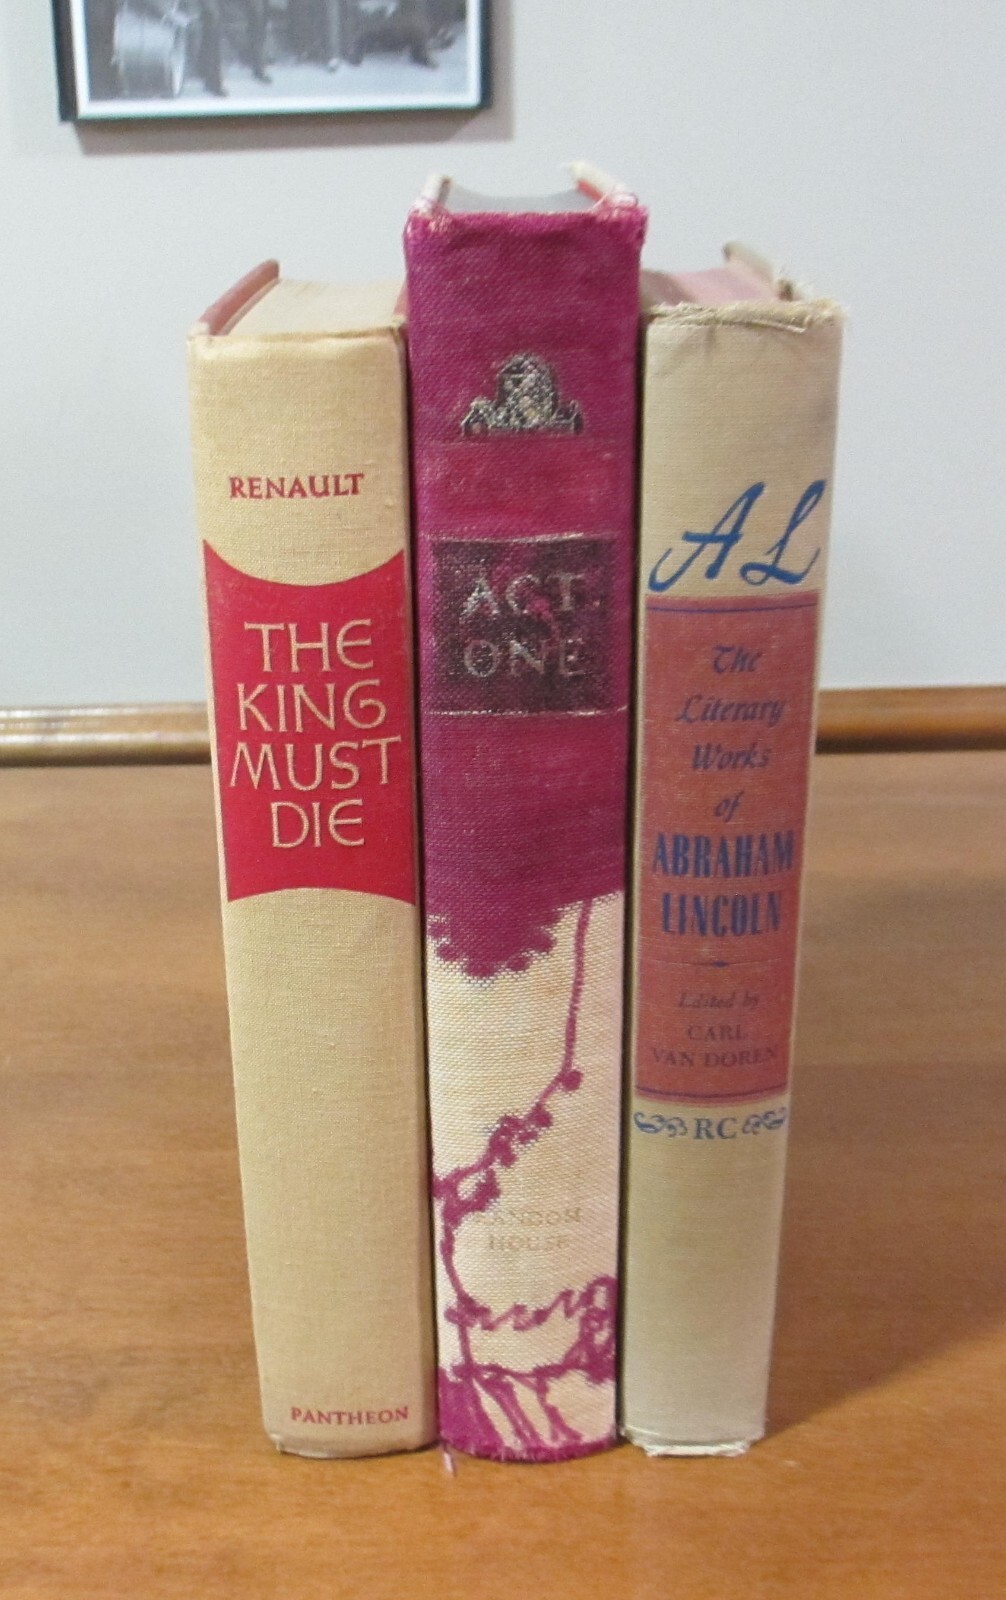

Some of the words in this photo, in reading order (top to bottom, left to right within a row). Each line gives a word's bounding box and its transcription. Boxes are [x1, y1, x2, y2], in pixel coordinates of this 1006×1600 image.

[228, 472, 365, 500] RENAULT
[459, 573, 587, 621] ACT
[244, 618, 374, 673] THE
[463, 636, 587, 678] ONE
[711, 645, 762, 675] The
[236, 678, 387, 733] KING
[676, 693, 785, 728] Literary
[229, 734, 401, 792] MUST
[691, 743, 769, 772] Works
[269, 798, 365, 849] DIE
[713, 790, 745, 823] of
[652, 829, 795, 879] ABRAHAM
[660, 891, 782, 938] LINCOLN
[678, 991, 737, 1009] Edited
[742, 990, 760, 1013] by
[686, 1023, 748, 1042] CARL
[650, 1046, 696, 1067] VAN
[703, 1043, 780, 1068] DOREN
[693, 1116, 738, 1141] RC
[290, 1406, 409, 1425] PANTHEON
